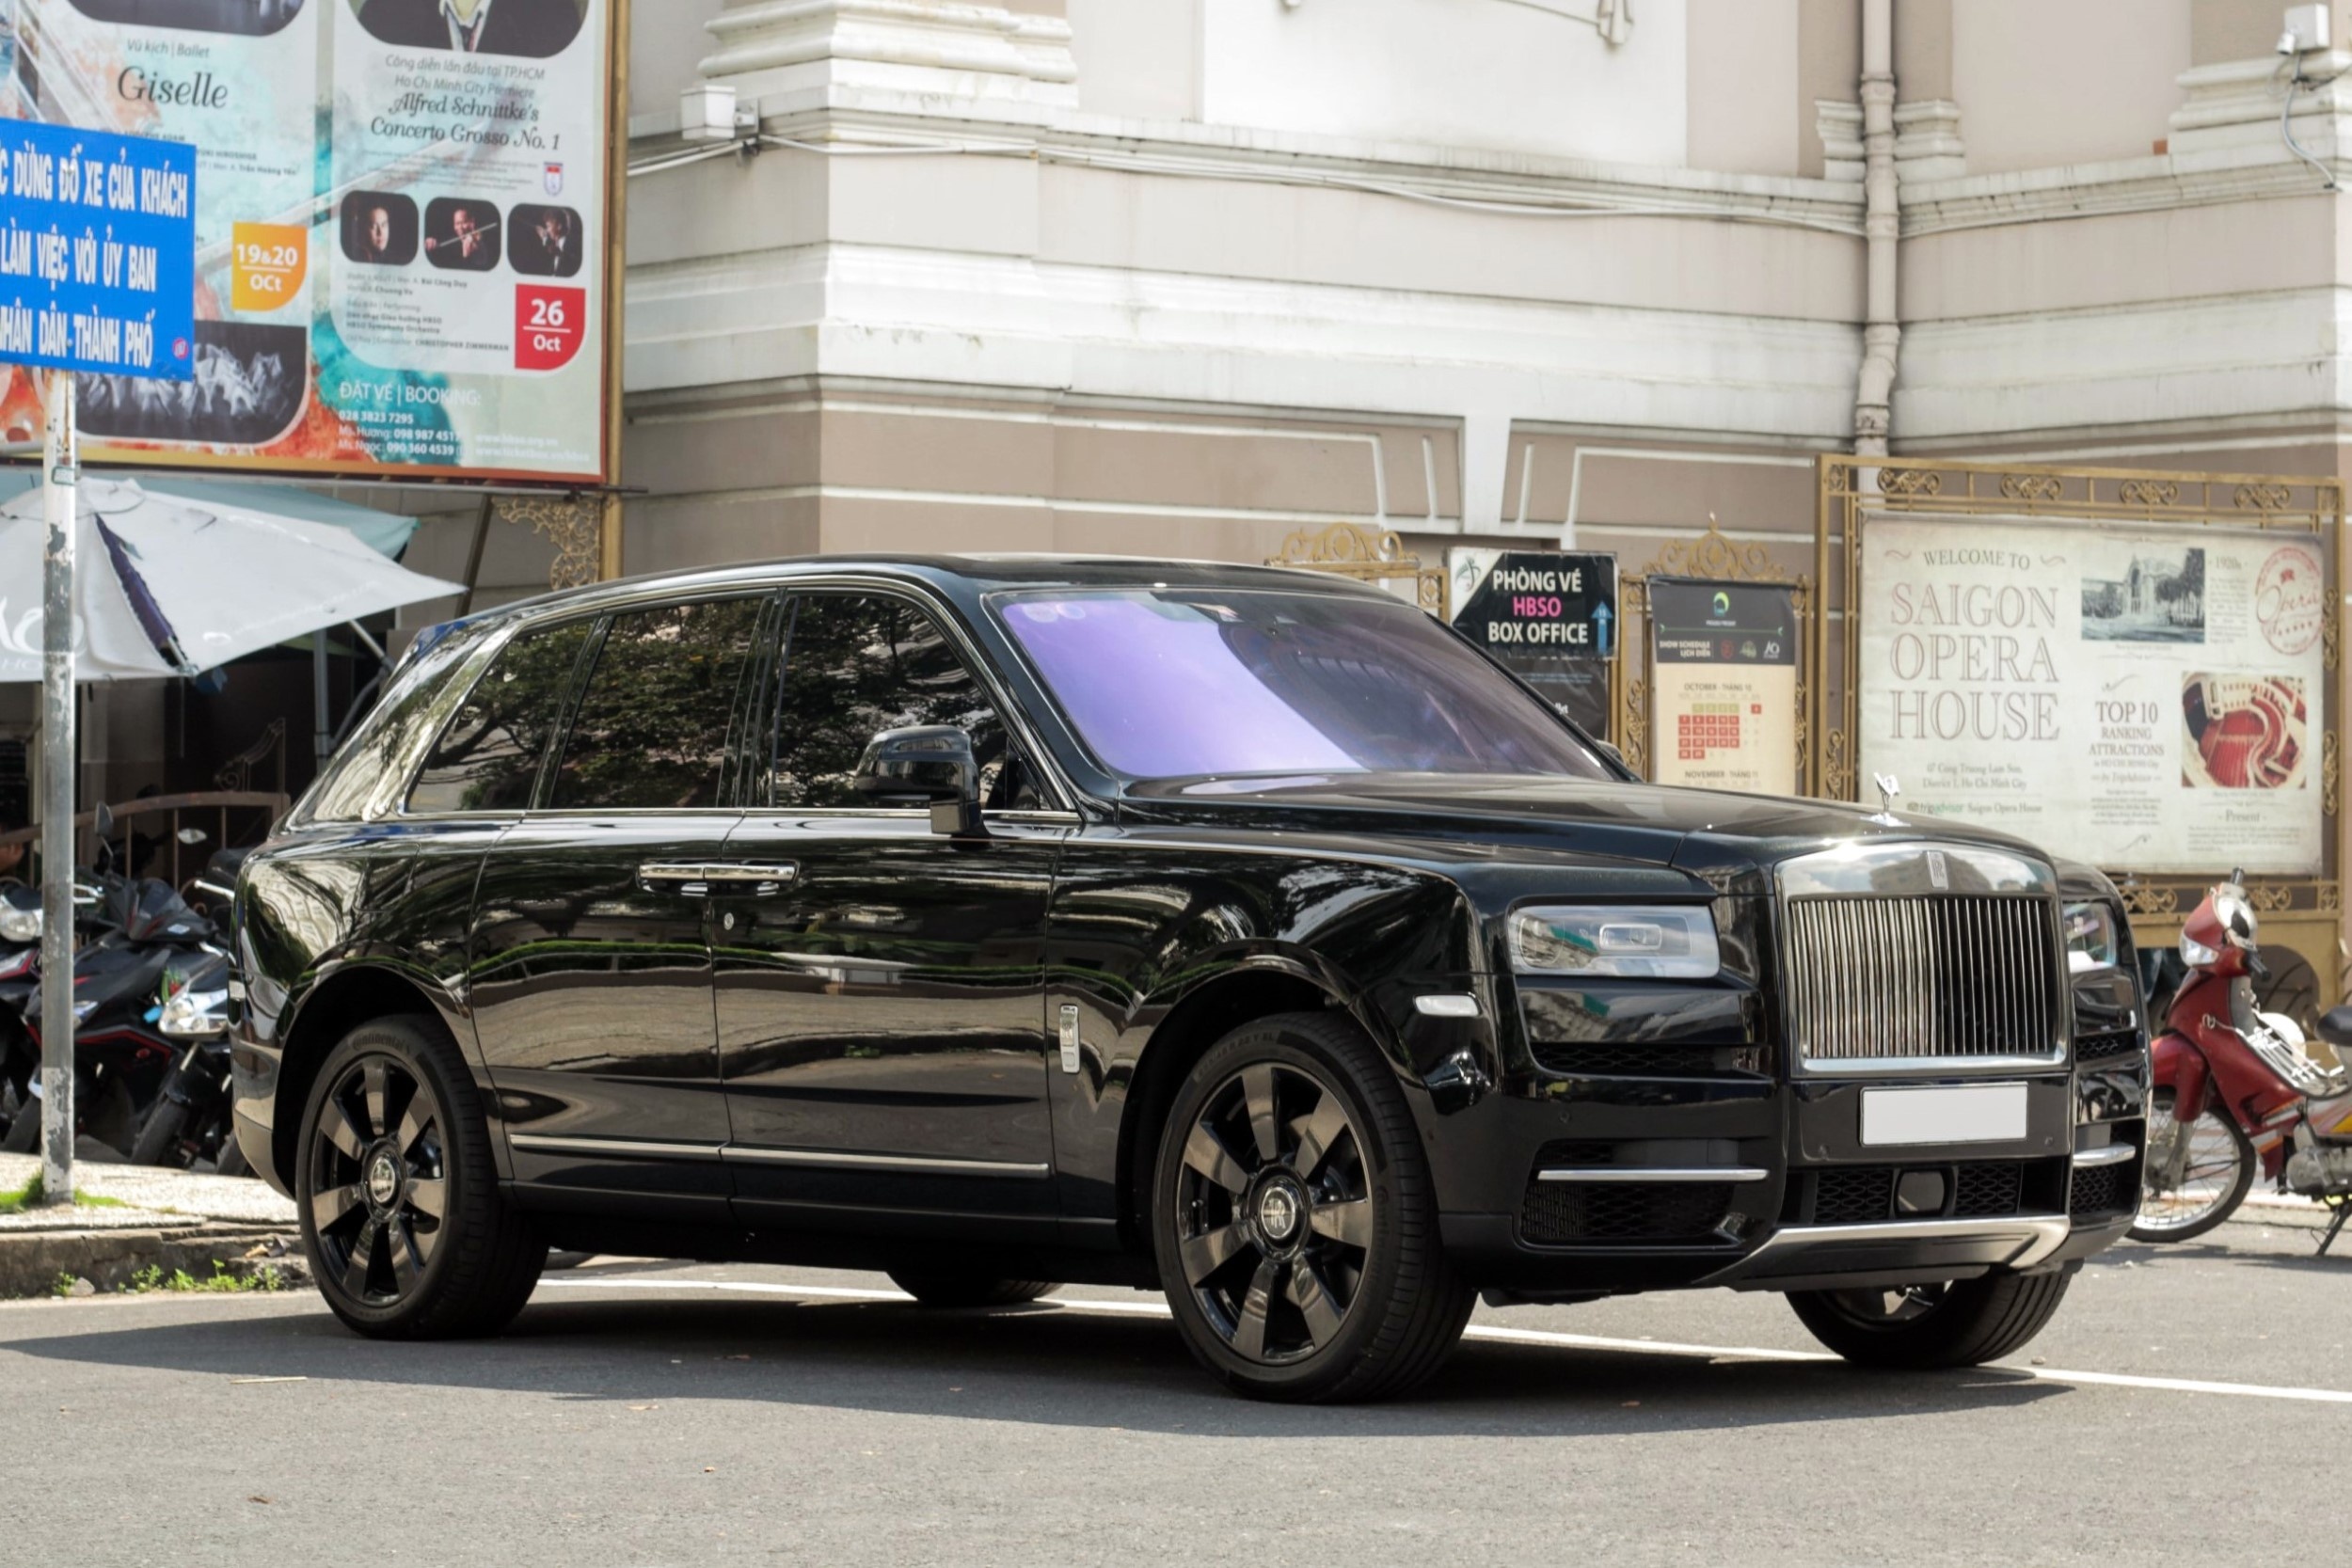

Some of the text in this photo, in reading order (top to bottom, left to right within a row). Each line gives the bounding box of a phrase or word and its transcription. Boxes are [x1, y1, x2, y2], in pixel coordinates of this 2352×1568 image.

[176, 42, 210, 57] Ballet
[385, 54, 415, 71] Công
[504, 65, 546, 81] TP.HCM
[118, 65, 229, 109] Giselle
[413, 75, 432, 89] Chi
[434, 77, 463, 92] Minh
[465, 79, 486, 95] City
[389, 92, 539, 122] Alfred Schnittke's
[371, 116, 561, 150] Concerto Grosso No. 1
[83, 160, 103, 207] XE
[107, 146, 135, 212] CỦA
[141, 159, 188, 219] KHÁCH
[1, 216, 157, 293] LÀM VIỆC VỚI ỦY BAN
[235, 243, 298, 268] 19&20
[531, 298, 565, 326] 26
[39, 300, 67, 357] DÂN
[73, 304, 120, 364] THÀNH
[124, 309, 156, 369] PHỐ
[532, 334, 561, 351] Oct
[374, 384, 393, 401] VÉ
[405, 386, 482, 406] BOOKING:
[339, 409, 414, 424] 028 3823 7295
[393, 428, 413, 439] 098
[415, 429, 434, 440] 987
[387, 442, 406, 454] 090
[428, 445, 453, 456] 4539
[1923, 548, 2031, 571] WELCOME TO
[1493, 566, 1582, 594] PHÒNG VÉ
[1513, 596, 1562, 617] HBSO
[1890, 581, 2059, 628] SAIGON
[1488, 621, 1588, 644] BOX OFFICE
[1890, 632, 2060, 684] OPERA
[1889, 689, 2061, 742] HOUSE
[2095, 700, 2158, 724] TOP 10
[2101, 725, 2152, 740] RANKING
[2089, 742, 2165, 756] ATTRACTIONS
[2225, 809, 2261, 823] Present
